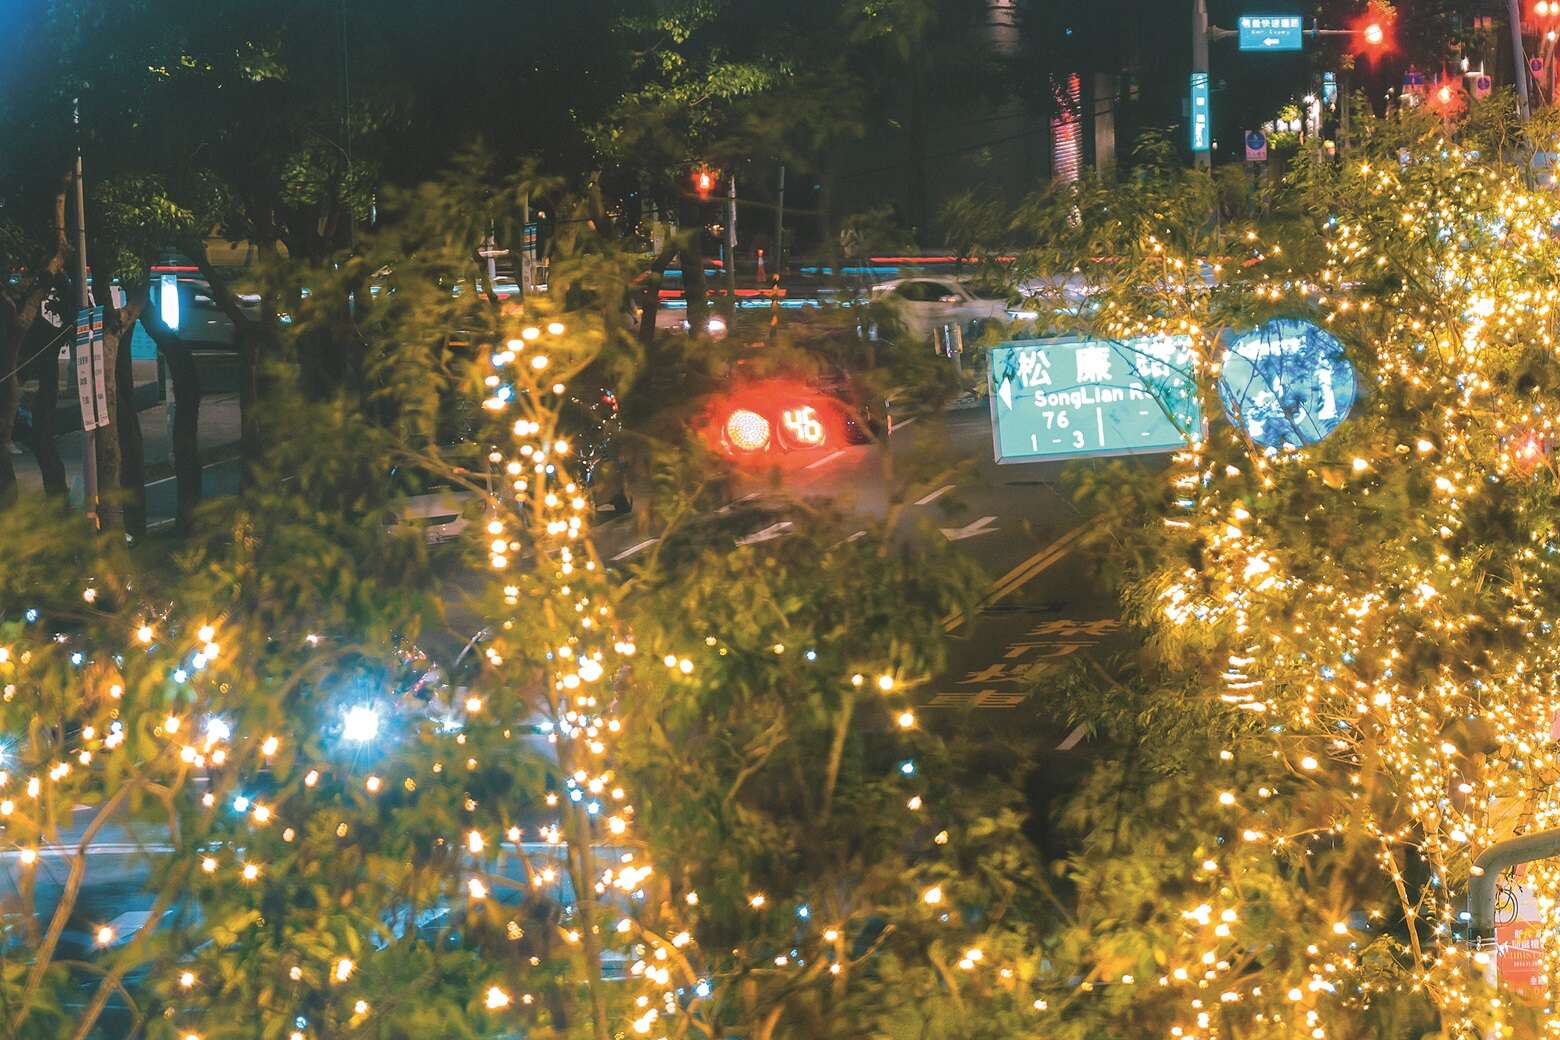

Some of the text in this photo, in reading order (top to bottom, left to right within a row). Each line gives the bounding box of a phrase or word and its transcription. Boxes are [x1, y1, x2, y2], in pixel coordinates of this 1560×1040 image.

[1034, 386, 1124, 409] SongLian
[783, 405, 823, 444] 46
[1042, 410, 1070, 429] 76
